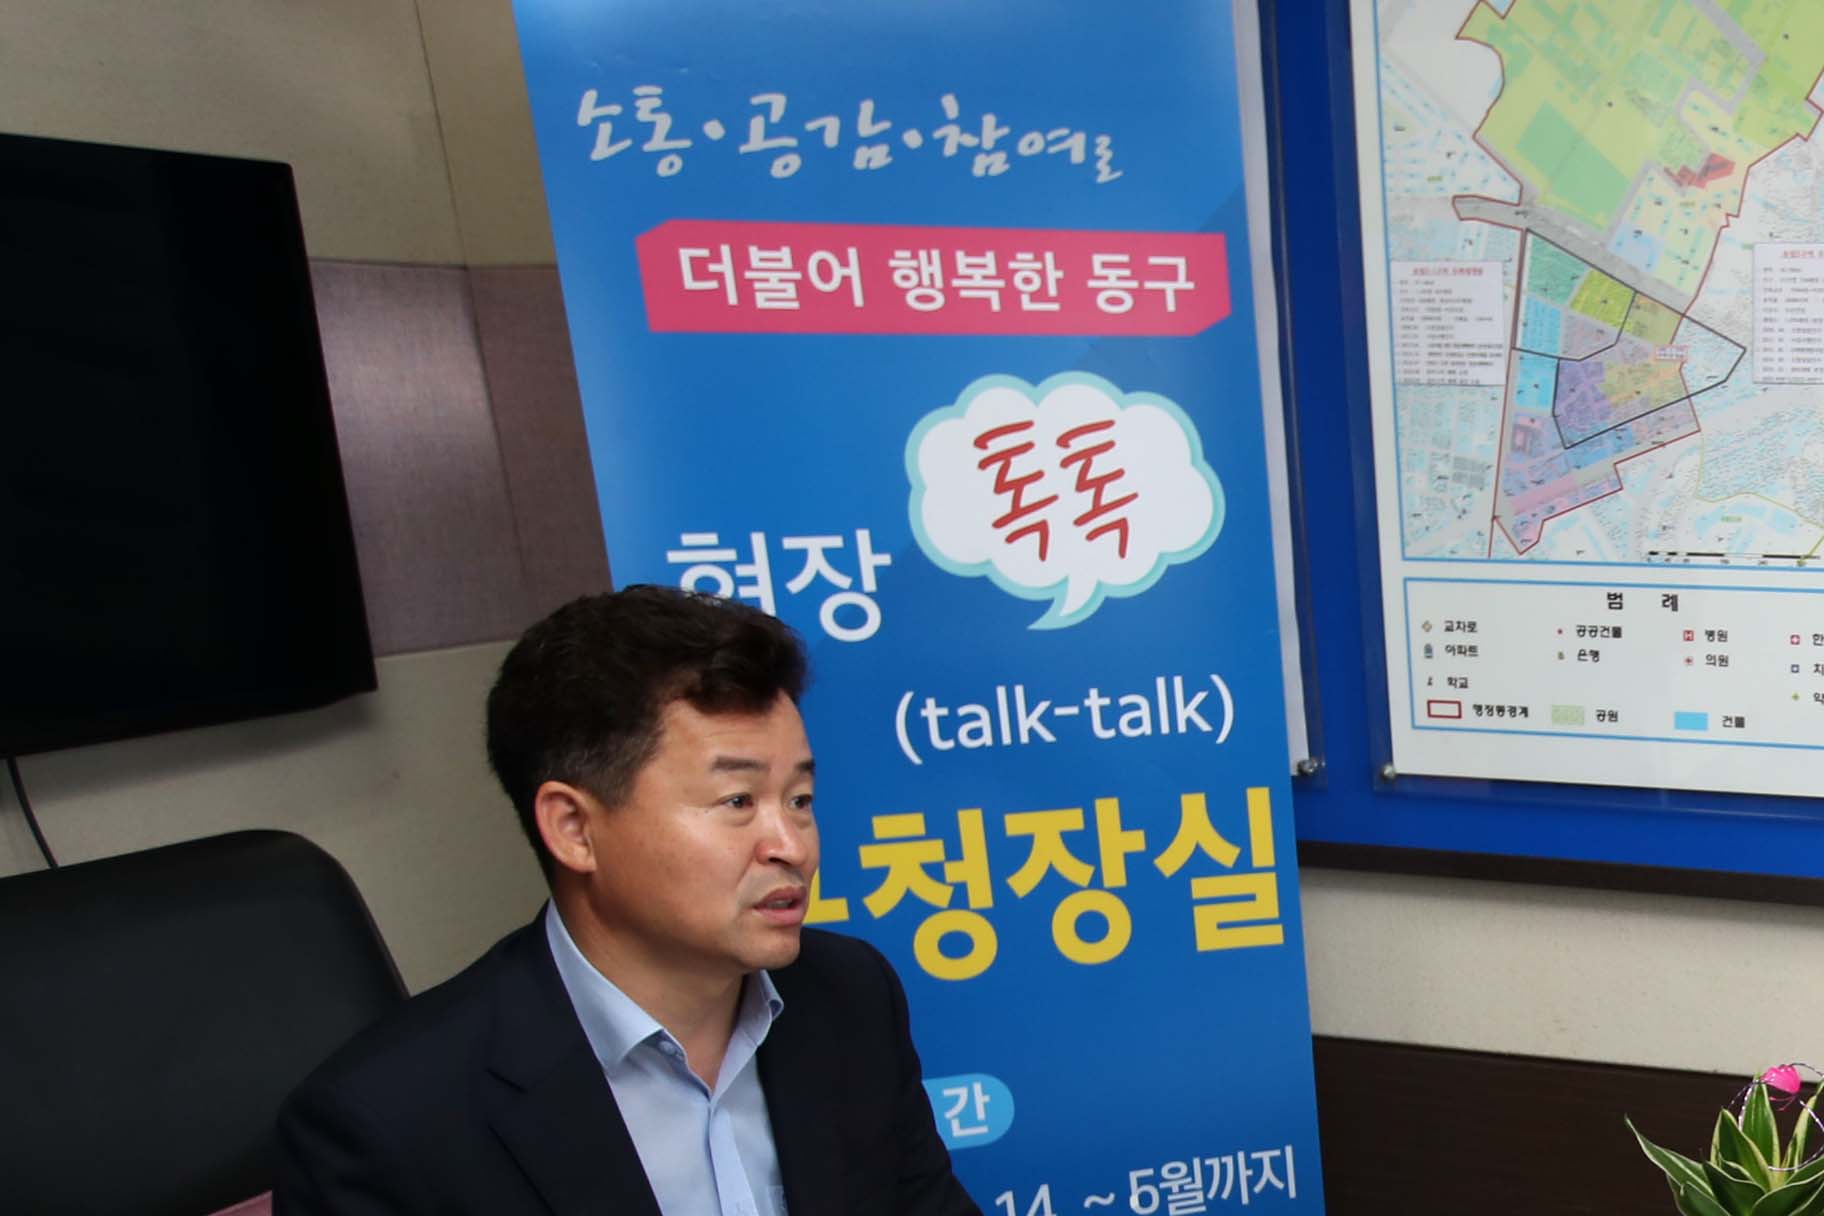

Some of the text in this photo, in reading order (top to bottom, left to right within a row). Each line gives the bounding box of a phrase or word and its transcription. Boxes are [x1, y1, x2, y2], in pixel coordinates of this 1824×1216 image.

[679, 242, 1196, 313] 더불어 행복한 동구
[973, 418, 1138, 561] 톡톡
[895, 674, 1236, 765] (talk-talk)
[803, 787, 1283, 981] 청장실
